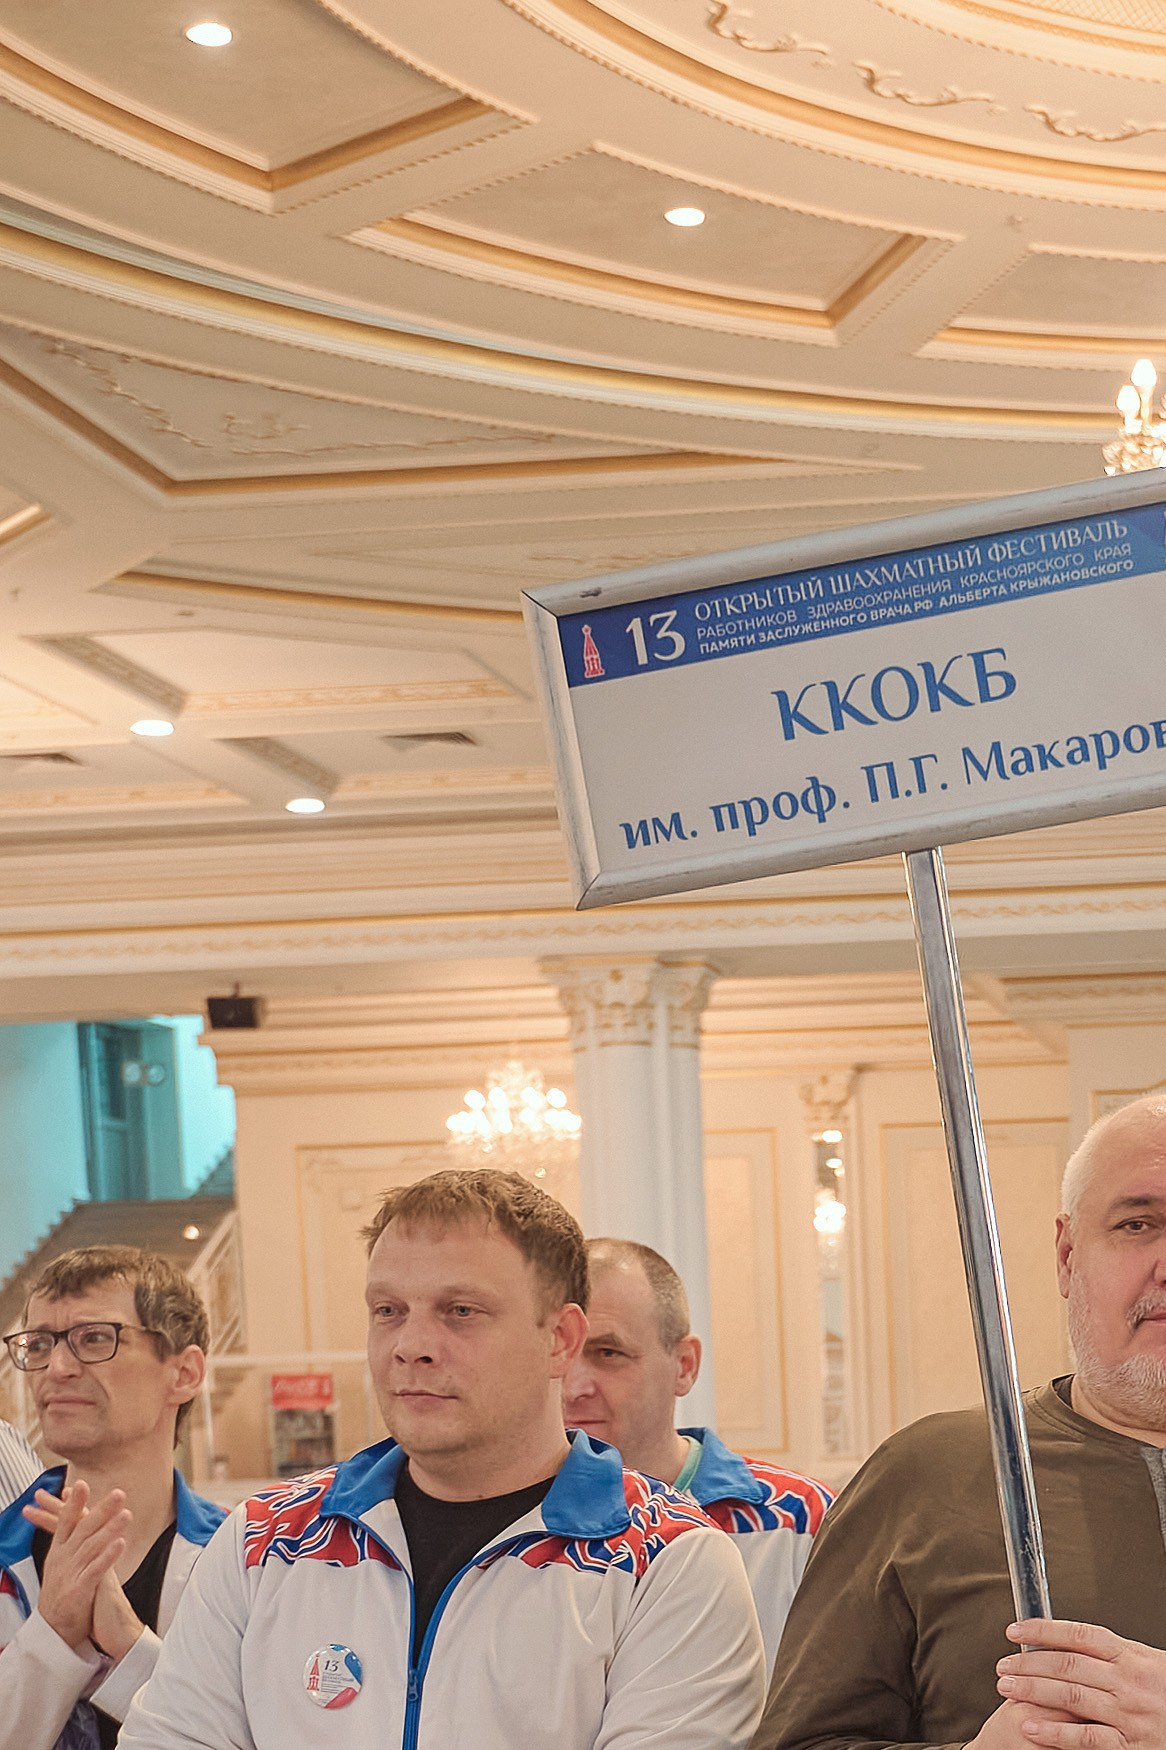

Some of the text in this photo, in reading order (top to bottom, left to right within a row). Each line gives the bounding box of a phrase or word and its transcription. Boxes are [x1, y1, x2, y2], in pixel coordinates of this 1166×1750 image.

[694, 519, 1128, 621] ОТКРЫТЫЙ ШАХМАТНЫЙ ФЕСТИВАЛЬ
[697, 543, 1131, 640] РАБОТНИКОВ ЗДРАВООХРАНЕНИЯ КРАСНОЯРСКОГО КРАЯ
[700, 560, 1134, 655] ПАМЯТИ ЗАСЛУЖЕННОГО ВРАЧА РФ АЛЬБЕРТА КРЫЖАНОВСКОГО
[626, 610, 686, 666] 13
[770, 647, 1018, 741] ККОКБ
[619, 813, 698, 850] им.
[709, 775, 850, 837] проф.
[861, 754, 949, 803] П.Г.
